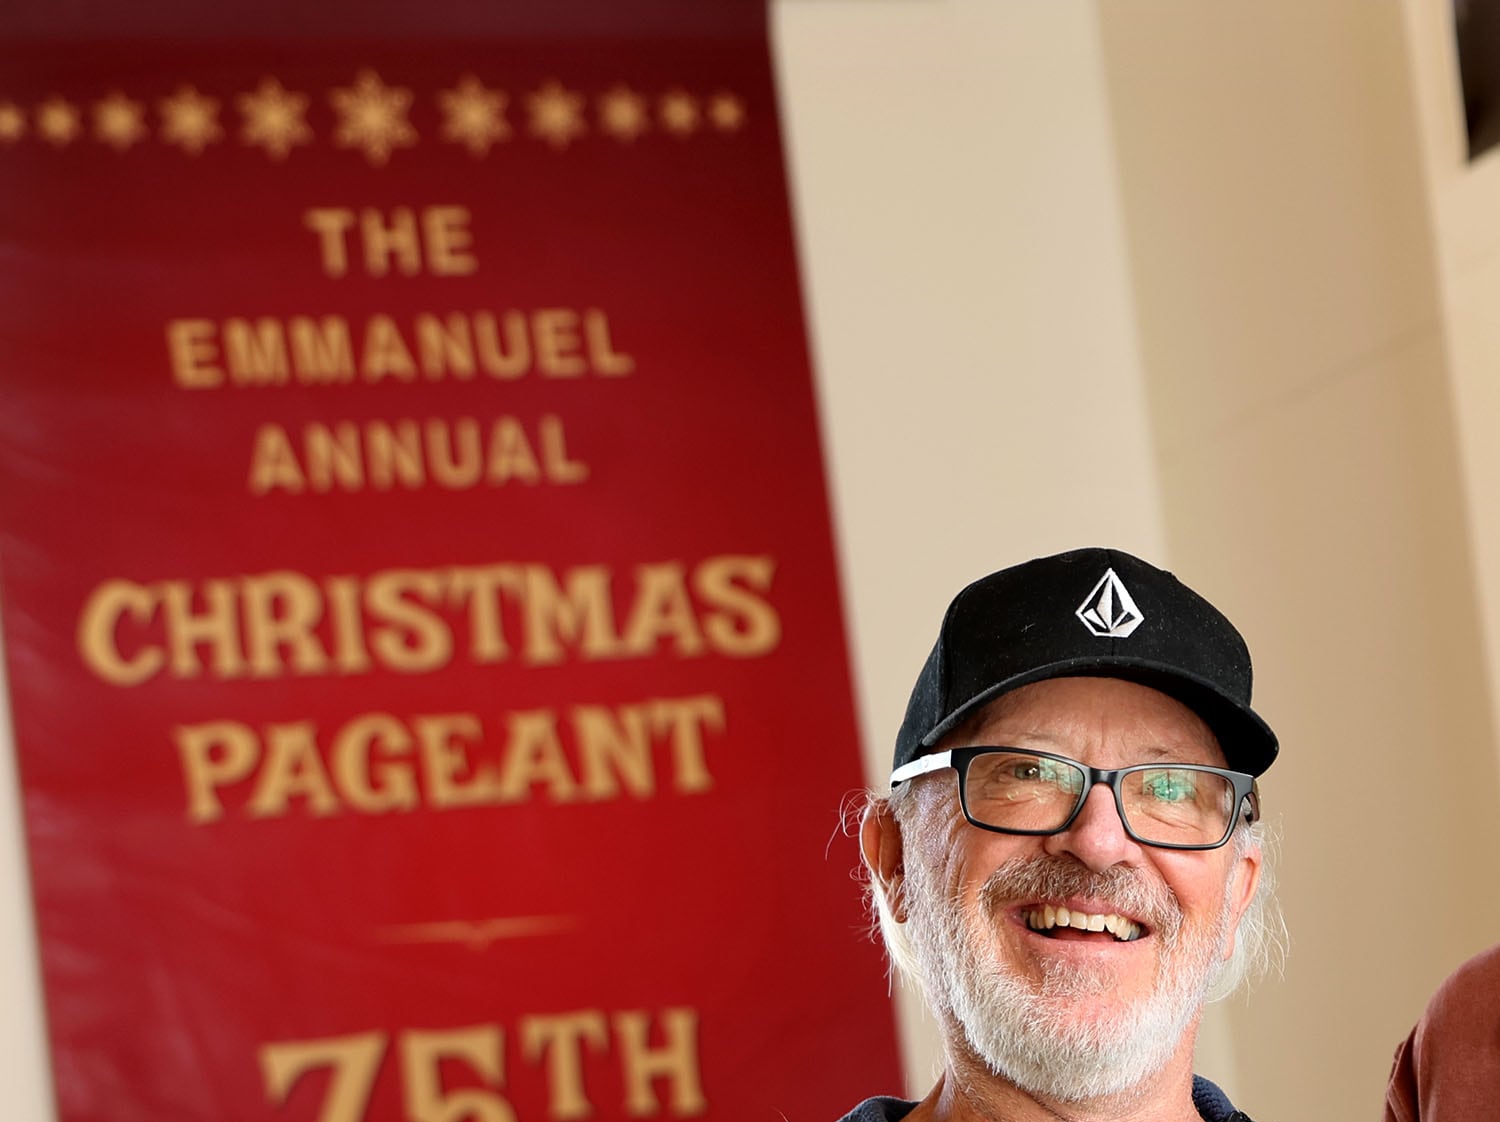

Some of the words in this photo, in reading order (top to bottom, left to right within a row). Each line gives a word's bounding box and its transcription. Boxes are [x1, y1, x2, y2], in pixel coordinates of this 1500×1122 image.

[306, 205, 479, 278] THE
[167, 307, 635, 389] EMMANUEL
[249, 415, 588, 494] ANNUAL
[78, 555, 782, 687] CHRISTMAS
[175, 694, 726, 824] PAGEANT
